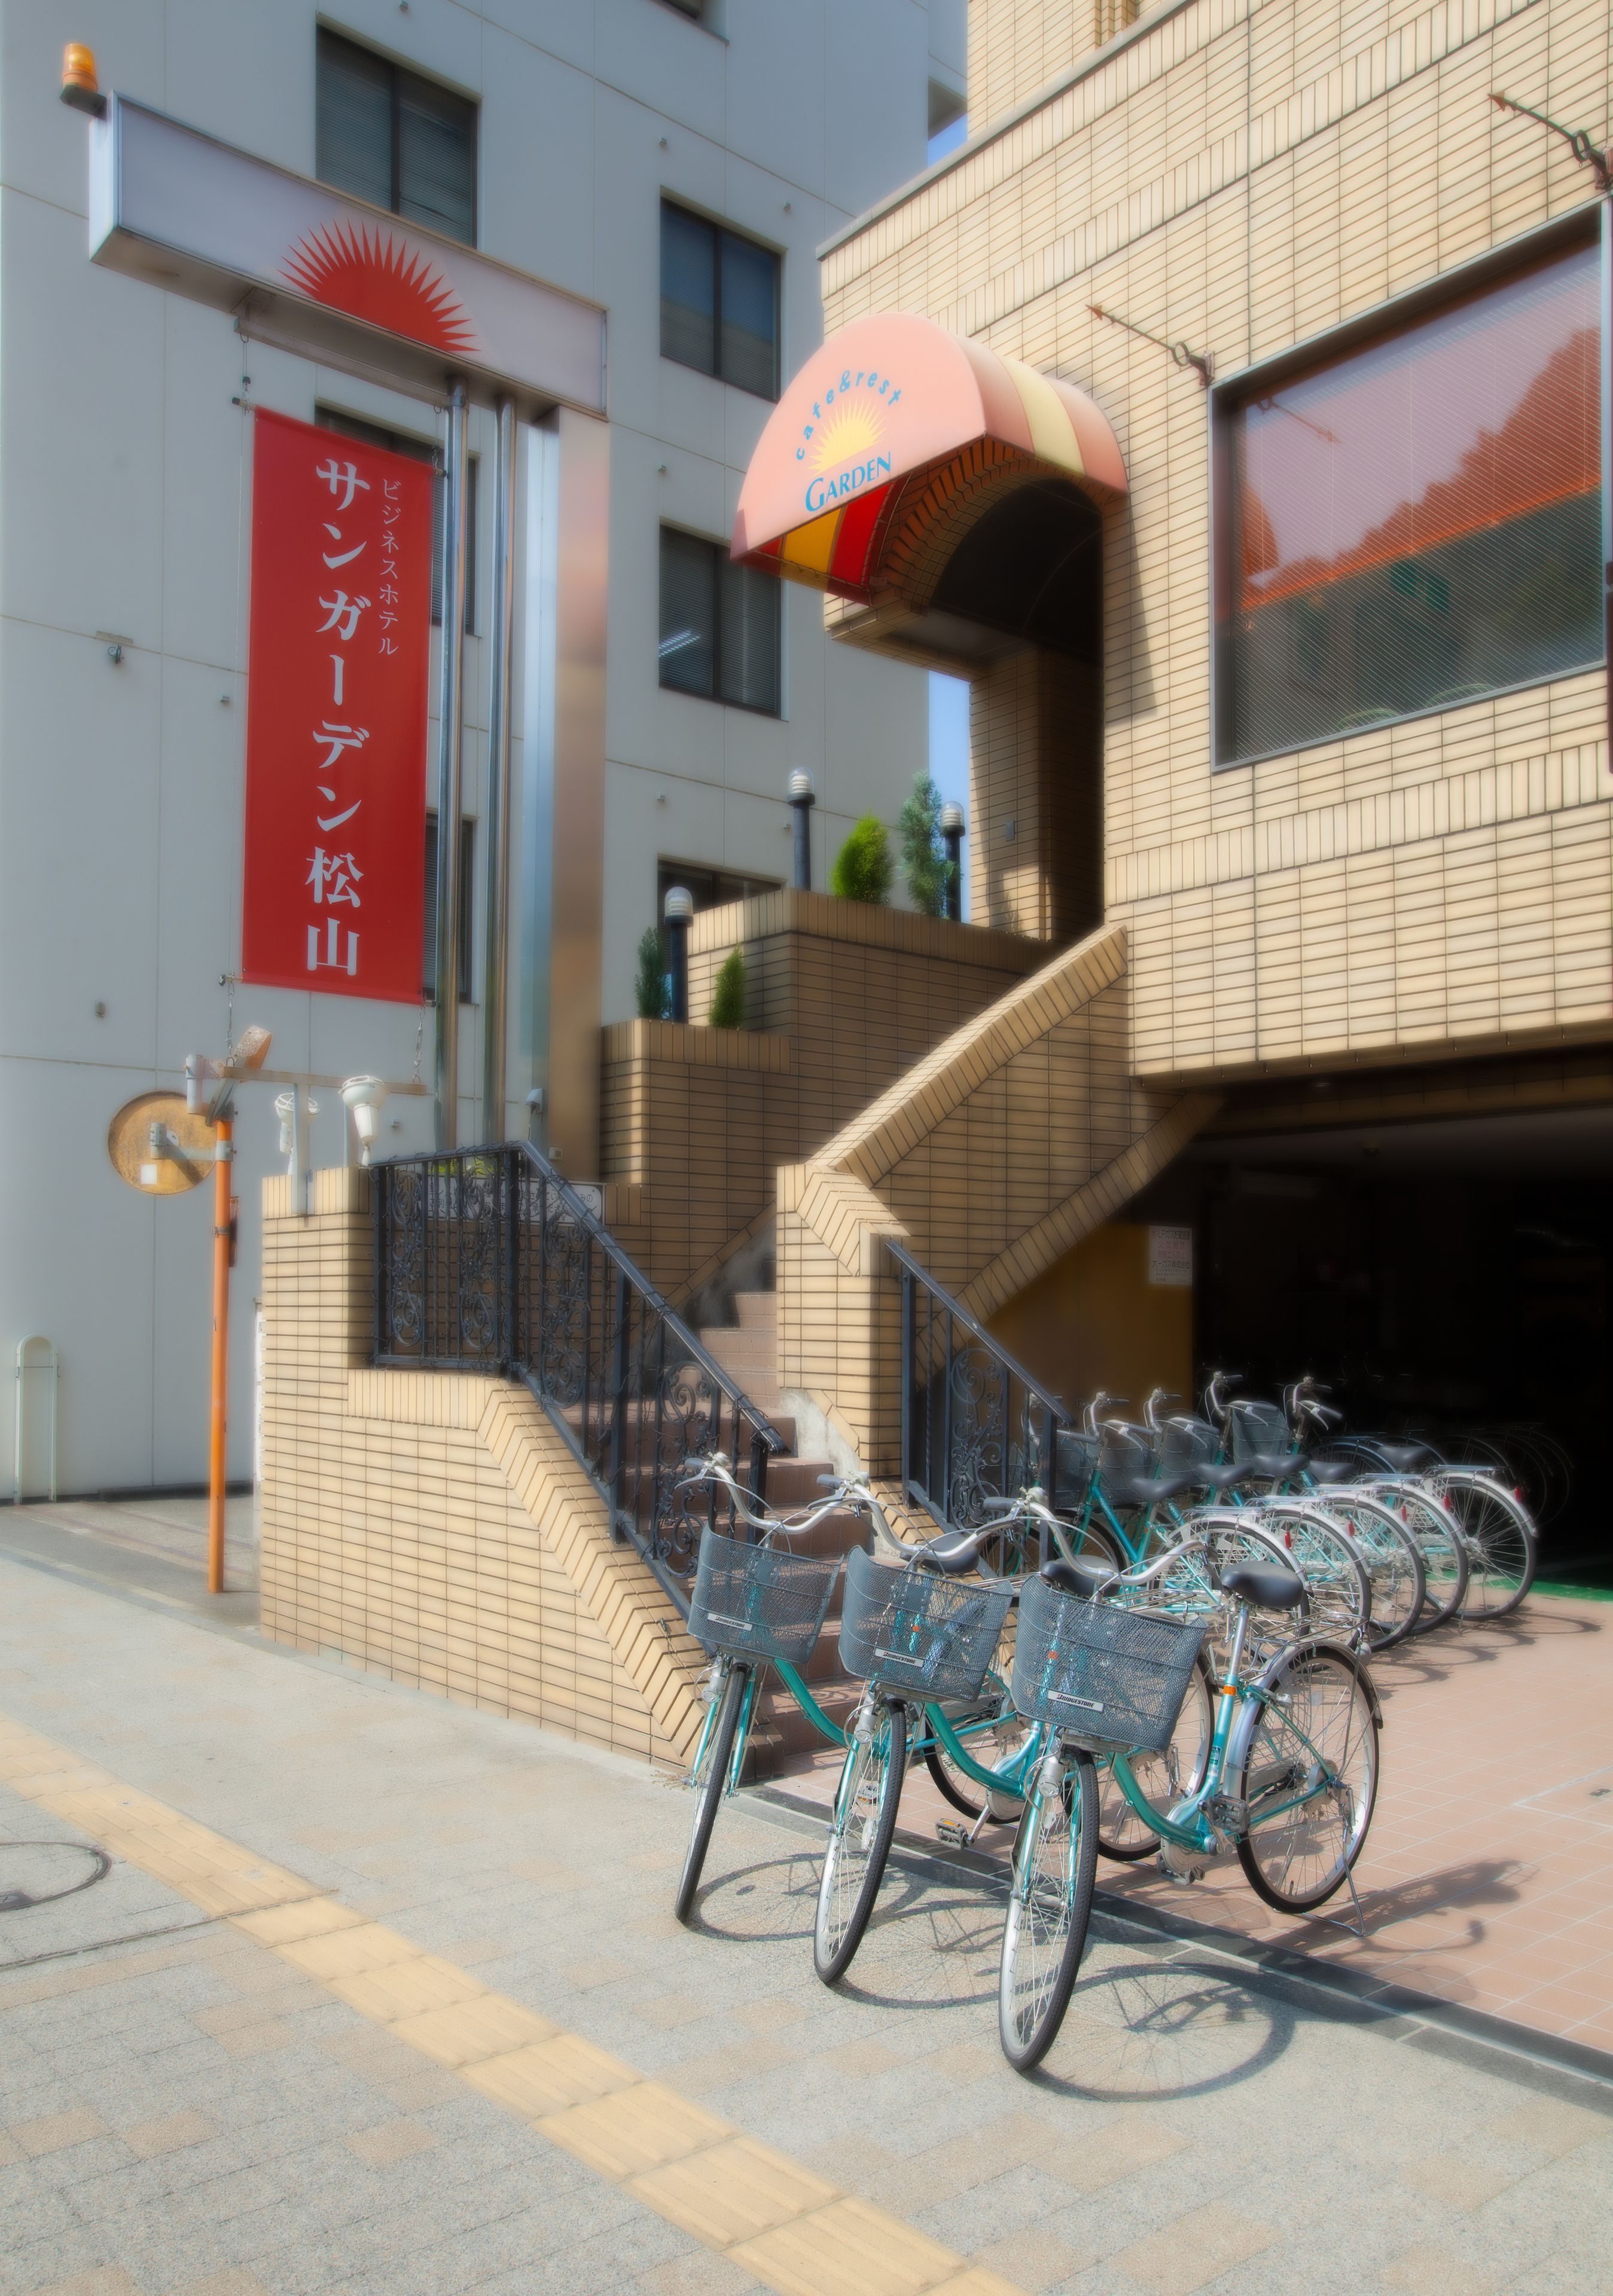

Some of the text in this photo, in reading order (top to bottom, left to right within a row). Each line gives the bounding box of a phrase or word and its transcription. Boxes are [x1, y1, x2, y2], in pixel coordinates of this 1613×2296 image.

[378, 478, 401, 656] ビジネスホテル
[304, 458, 371, 977] サンガーデン松山
[715, 1616, 746, 1628] BRIDGESTONE
[883, 1651, 917, 1664] BRIDGESTONE
[1056, 1693, 1095, 1708] BRIDGESTONE
